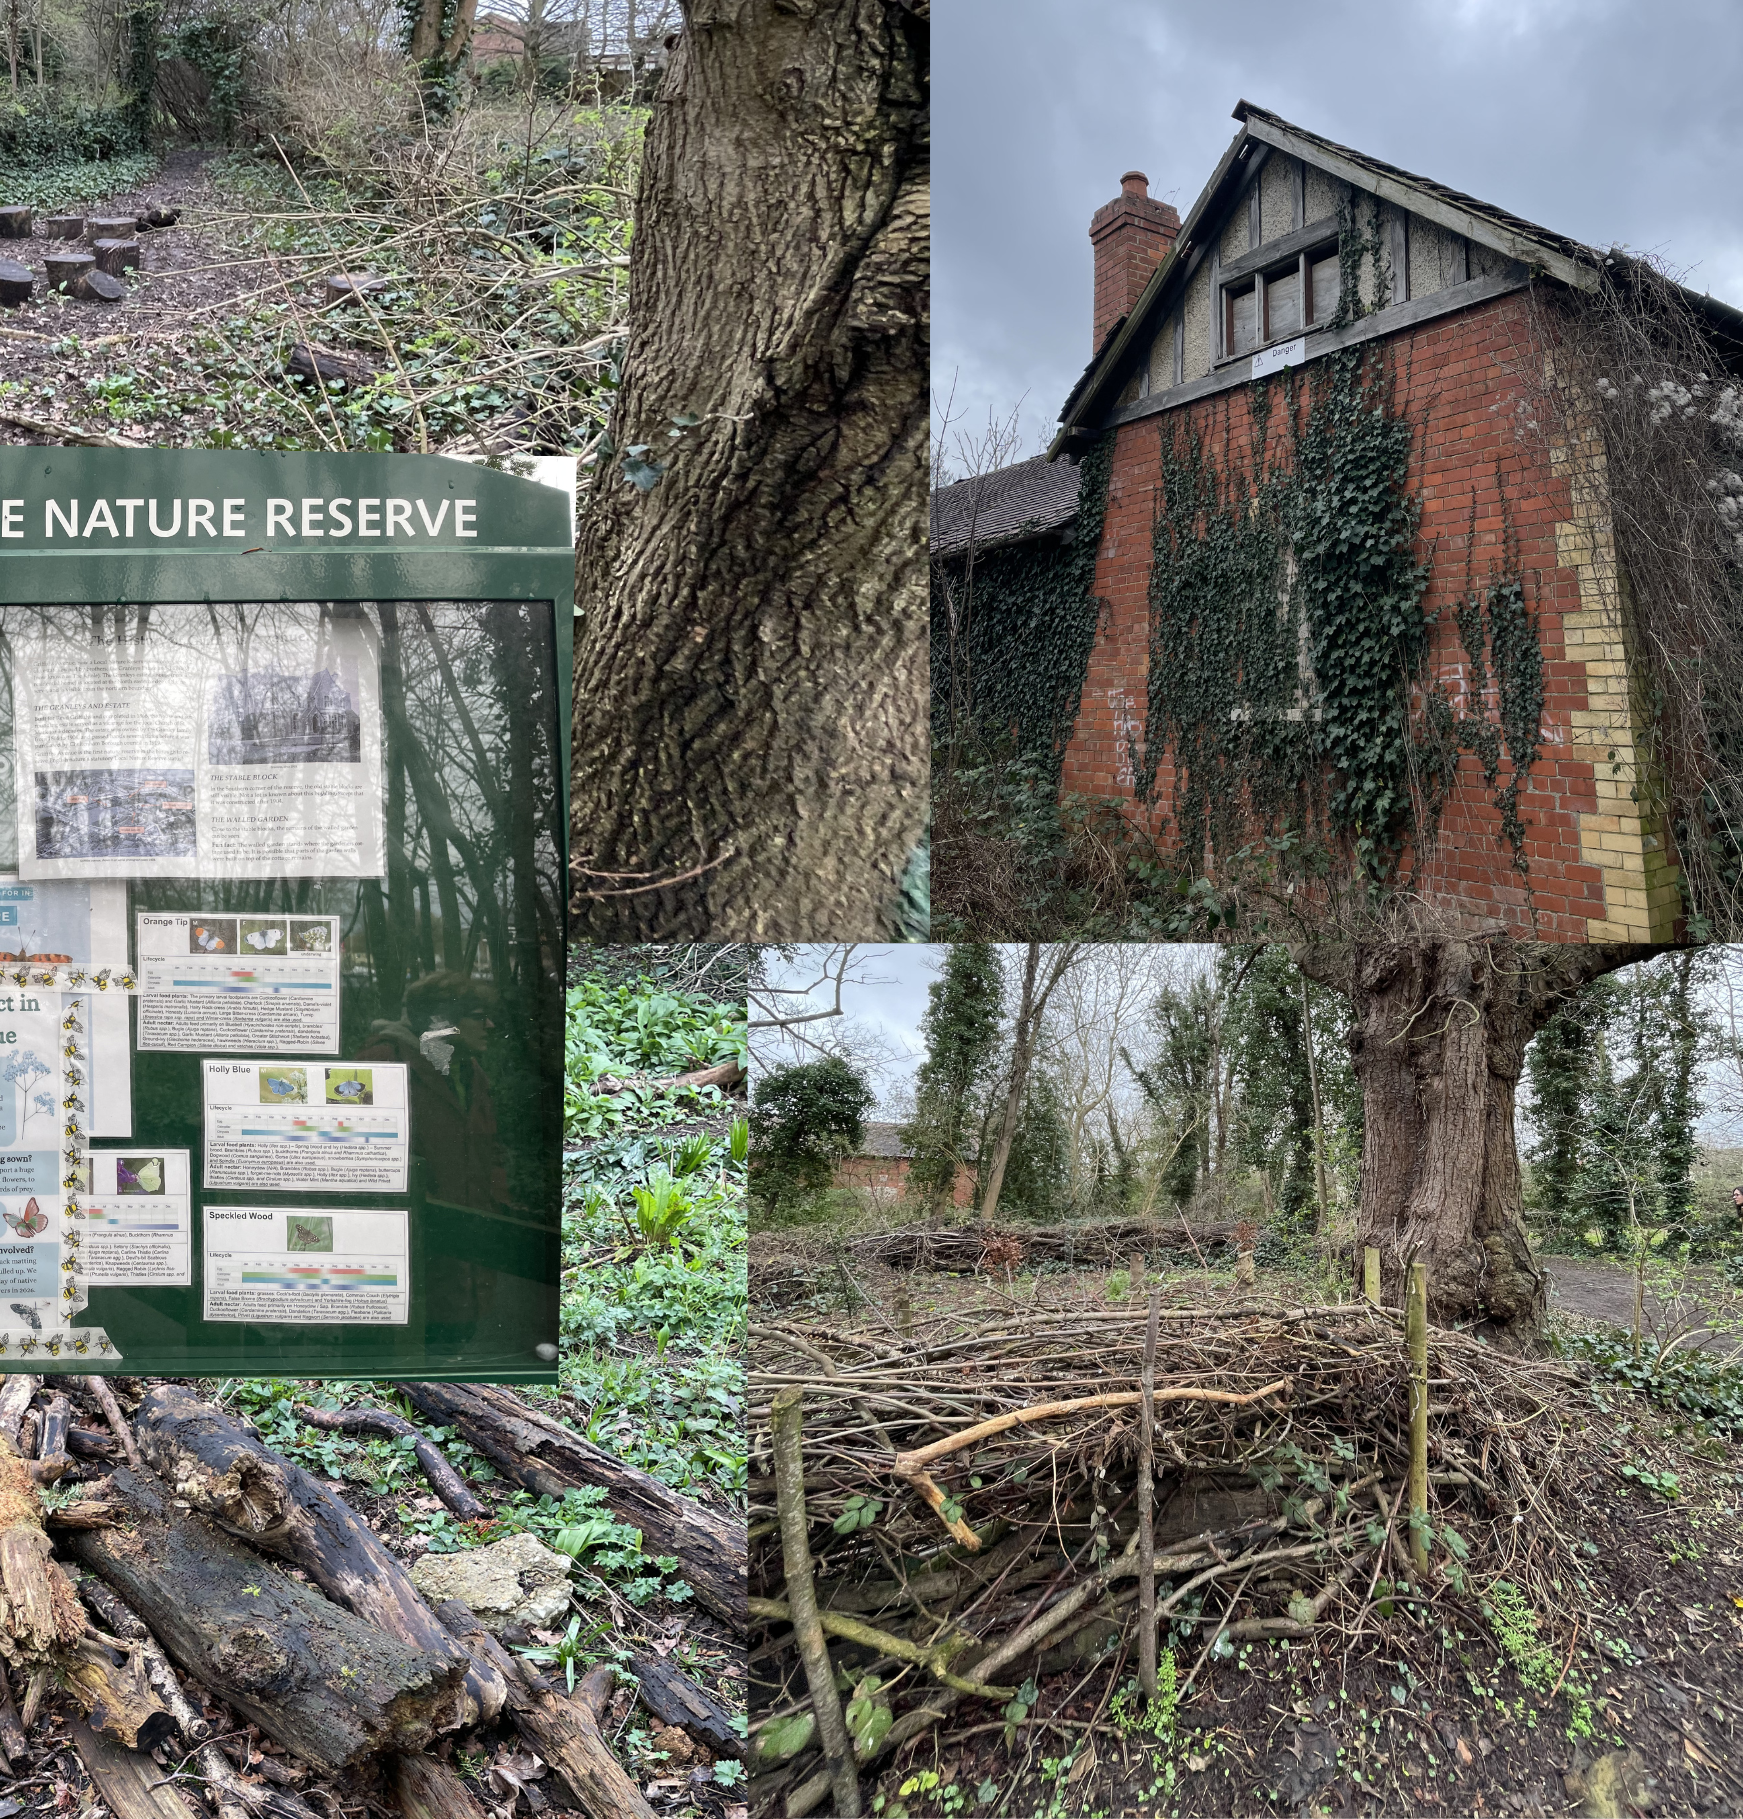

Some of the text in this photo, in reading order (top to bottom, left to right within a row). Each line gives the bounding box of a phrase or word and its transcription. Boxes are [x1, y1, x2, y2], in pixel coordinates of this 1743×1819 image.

[1272, 344, 1297, 357] Danger
[44, 498, 246, 538] NATURE
[266, 498, 478, 538] RESERVE
[143, 918, 188, 927] Orange Tip
[19, 993, 41, 1012] in
[209, 1065, 251, 1074] Holly Blue
[6, 1154, 33, 1162] sown?
[209, 1212, 273, 1220] Speckled Wood
